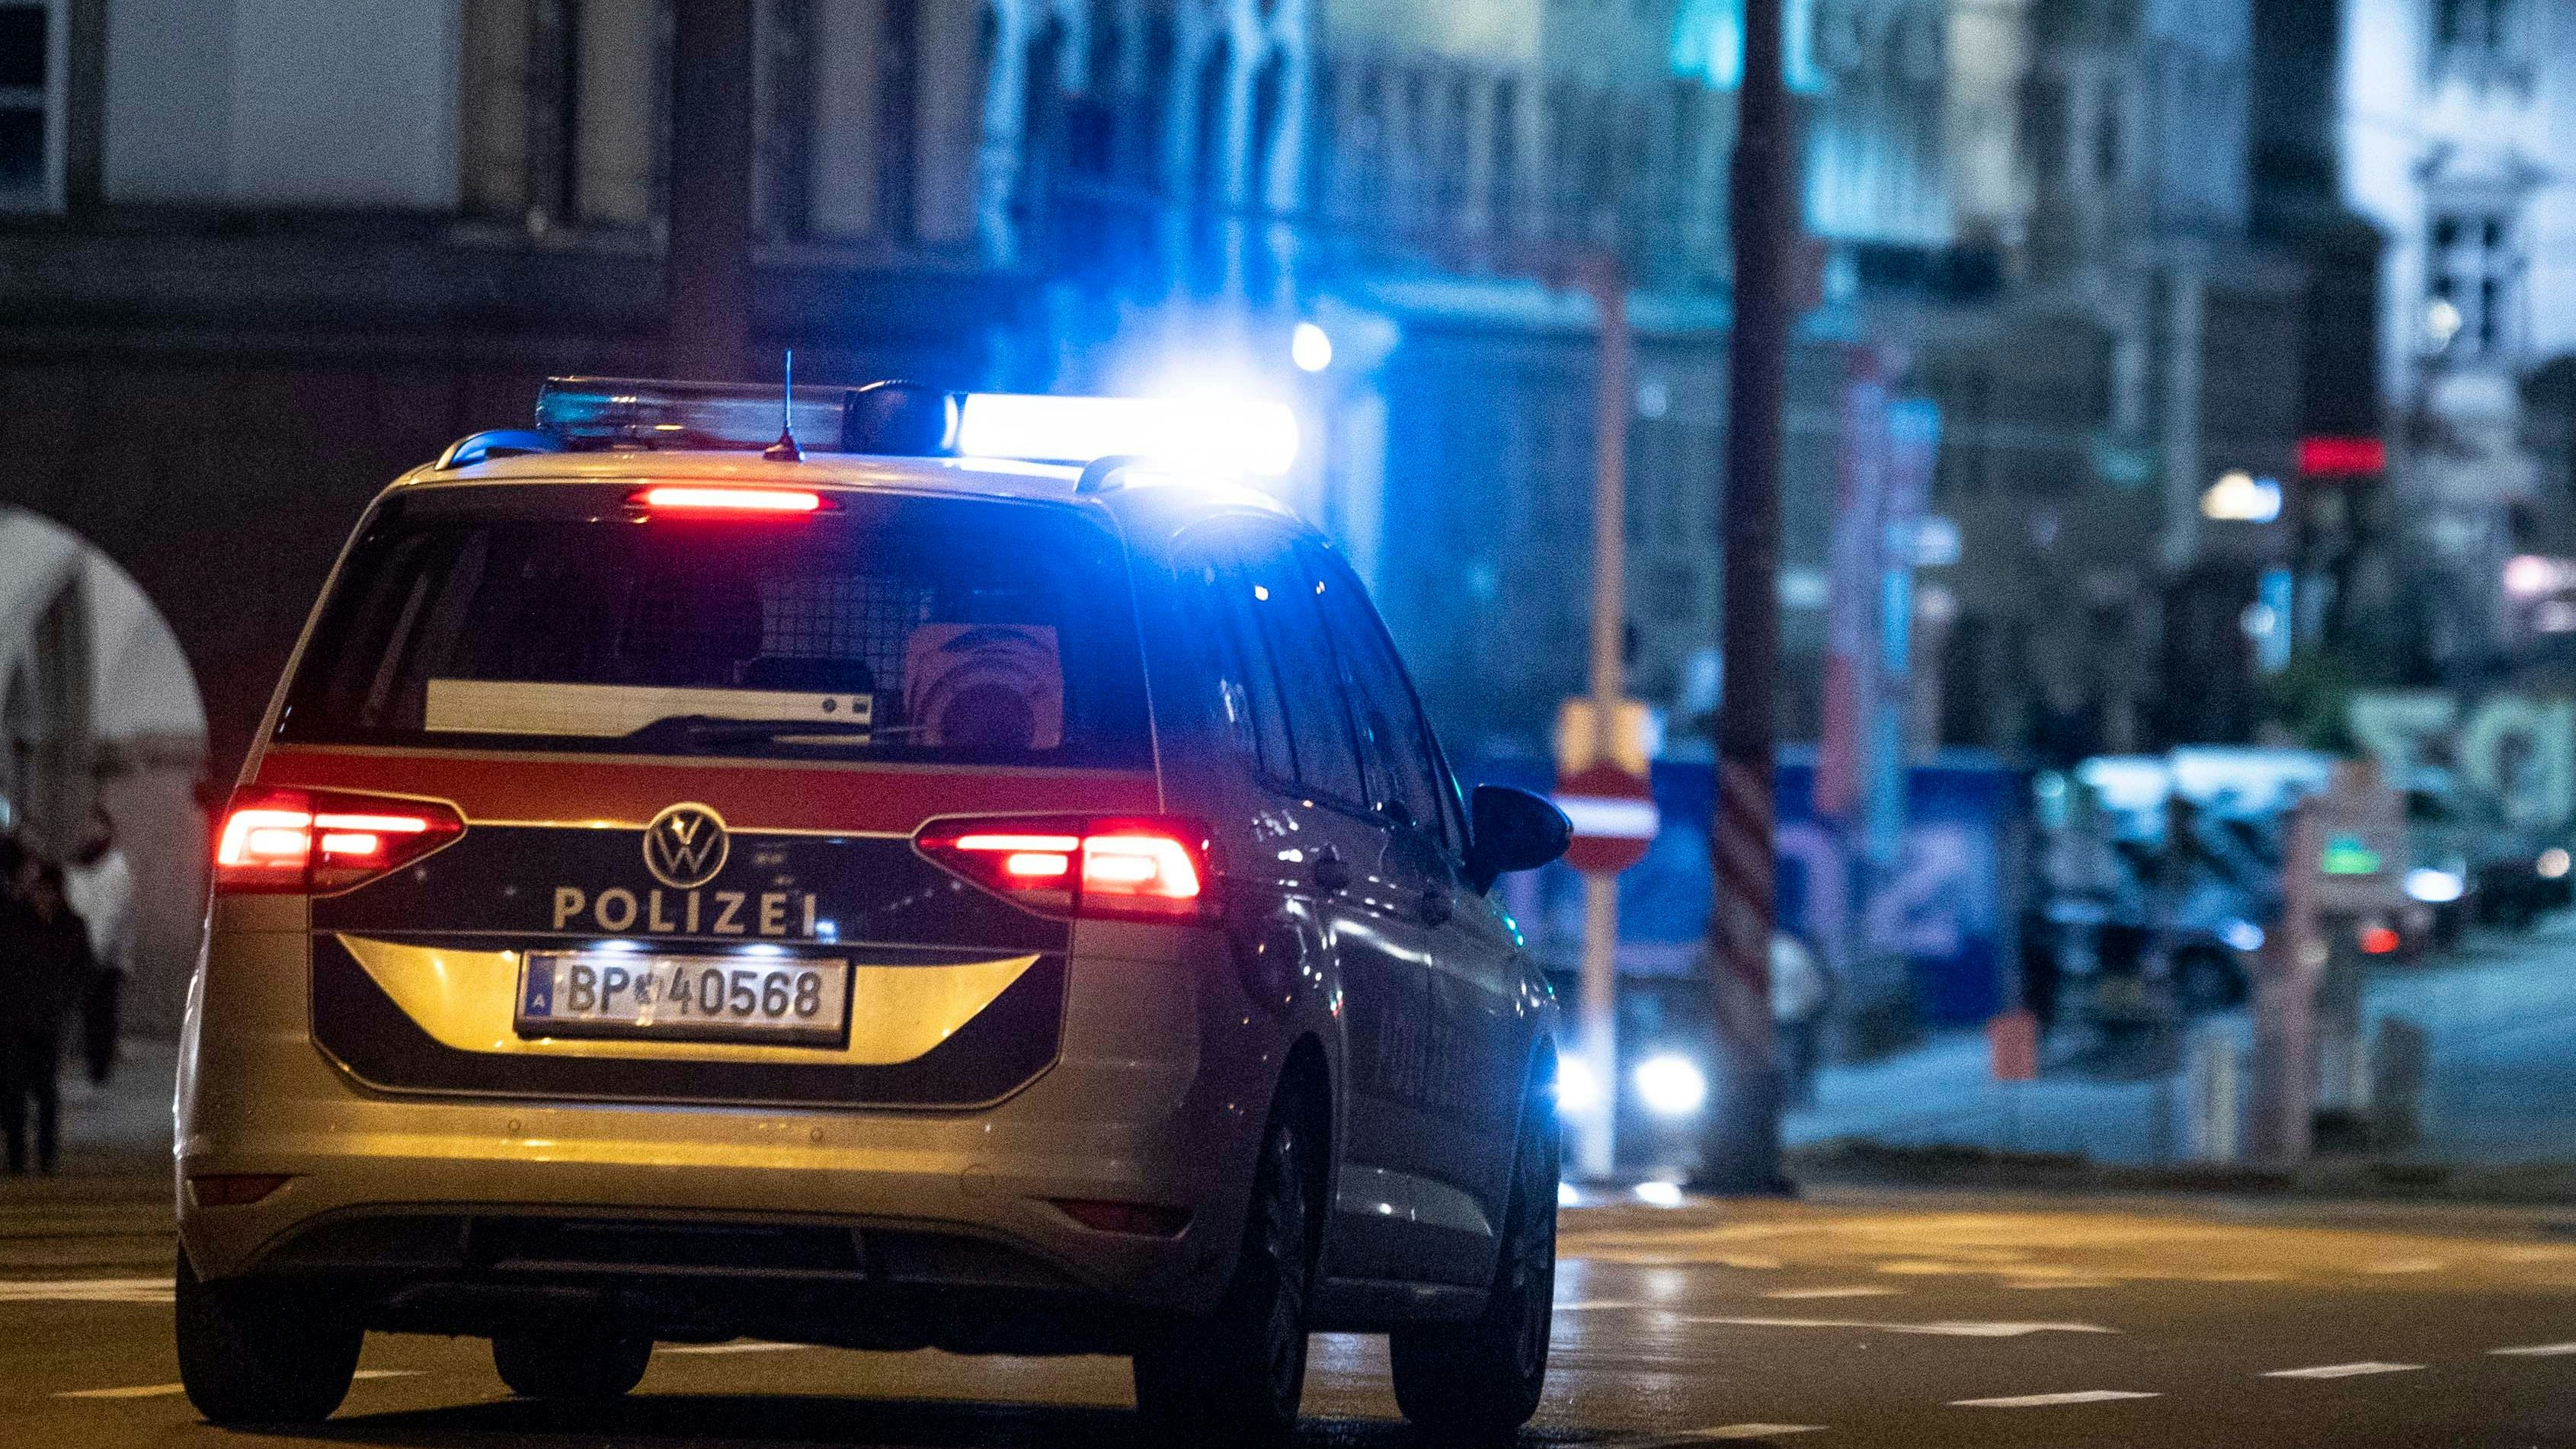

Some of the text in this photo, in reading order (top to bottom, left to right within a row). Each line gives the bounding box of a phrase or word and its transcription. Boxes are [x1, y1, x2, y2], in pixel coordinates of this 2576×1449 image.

[552, 886, 817, 936] POLIZEI
[568, 964, 630, 1013] BP
[667, 966, 823, 1019] 40568
